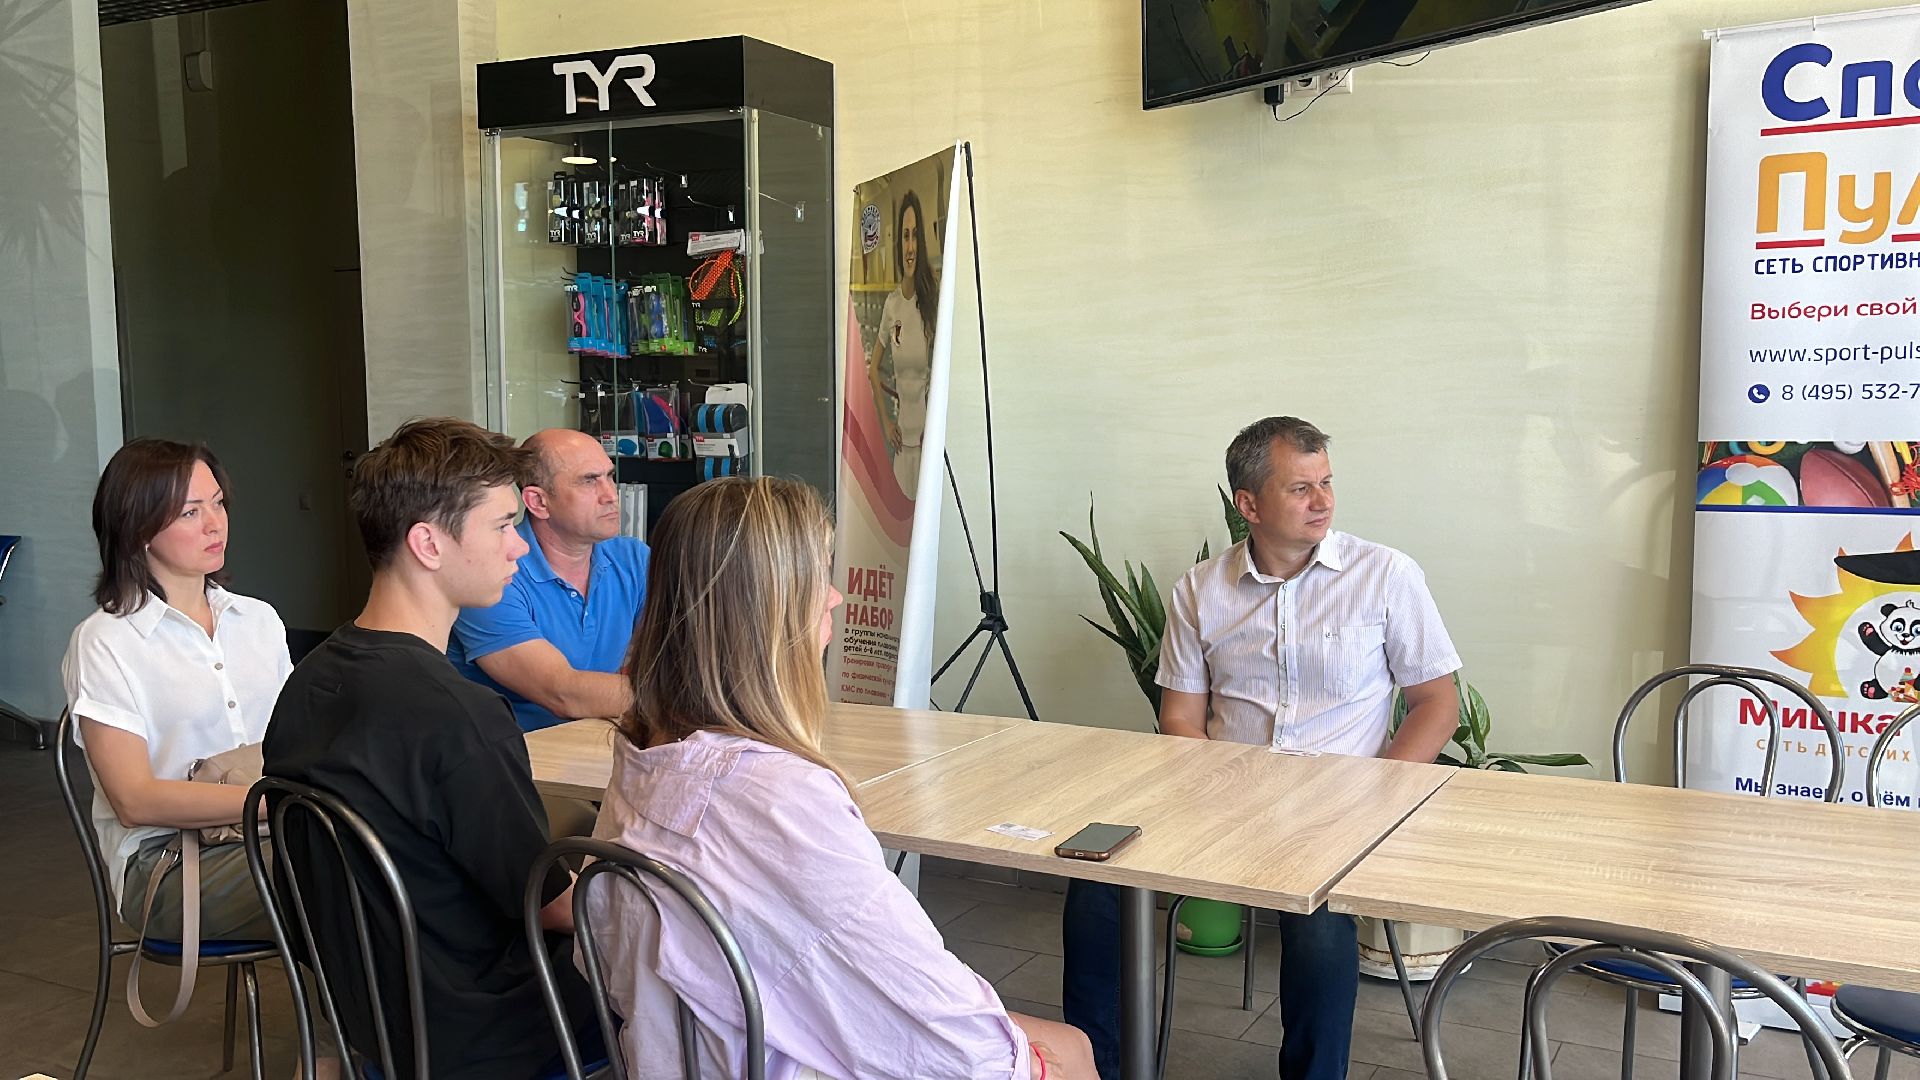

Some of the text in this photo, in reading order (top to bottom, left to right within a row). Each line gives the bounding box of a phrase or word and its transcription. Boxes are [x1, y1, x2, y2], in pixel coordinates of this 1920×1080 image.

[553, 54, 656, 114] TYR
[1754, 258, 1804, 275] СЕТЬ
[1750, 297, 1917, 322] Выбери свой
[1781, 383, 1920, 401] 8 (495) 532-7
[847, 564, 894, 602] ИДЁТ
[845, 602, 894, 630] НАБОР
[1756, 738, 1807, 754] СТЬ
[1851, 791, 1864, 802] о
[1878, 790, 1911, 808] ём
